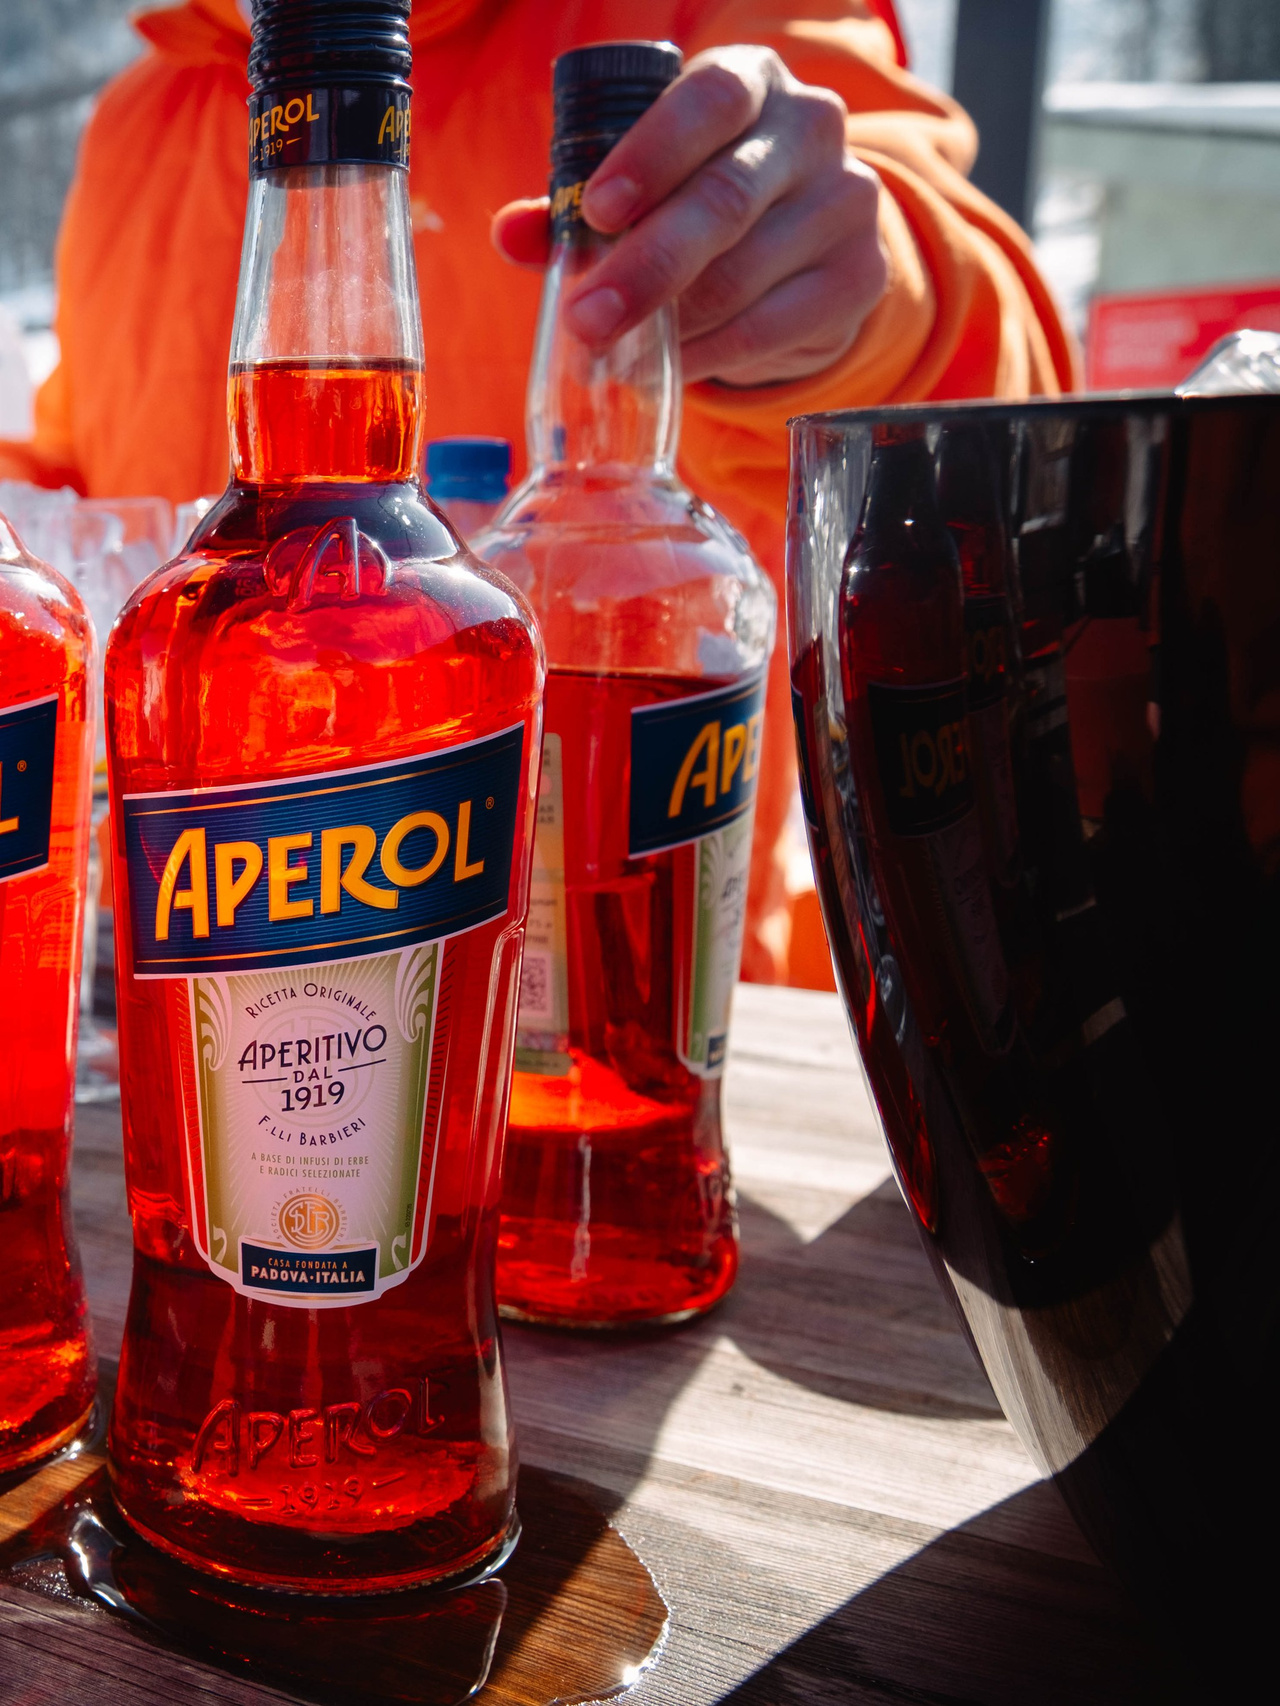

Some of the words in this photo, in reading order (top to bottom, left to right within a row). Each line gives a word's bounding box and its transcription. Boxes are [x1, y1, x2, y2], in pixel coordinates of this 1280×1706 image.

[259, 138, 284, 162] 1919
[245, 987, 298, 1019] RICETTA
[303, 982, 377, 1021] ORIGINALE
[237, 1024, 387, 1072] APERITIVO
[292, 1066, 333, 1084] DAL
[281, 1081, 345, 1112] 1919
[258, 1115, 292, 1142] F.LLI
[299, 1117, 366, 1146] BARBIERI
[251, 1152, 257, 1161] A
[260, 1153, 281, 1164] BASE
[286, 1155, 295, 1165] DI
[299, 1156, 330, 1166] INFUSI
[334, 1157, 344, 1166] DI
[347, 1155, 369, 1165] ERBE
[260, 1165, 264, 1174] E
[268, 1166, 298, 1177] RADICI
[302, 1168, 361, 1178] SELEZIONATE
[268, 1257, 290, 1269] CASA
[295, 1260, 337, 1270] FONDATA
[342, 1261, 348, 1270] A
[190, 1376, 446, 1478] APEROL
[279, 1477, 365, 1516] 1919
